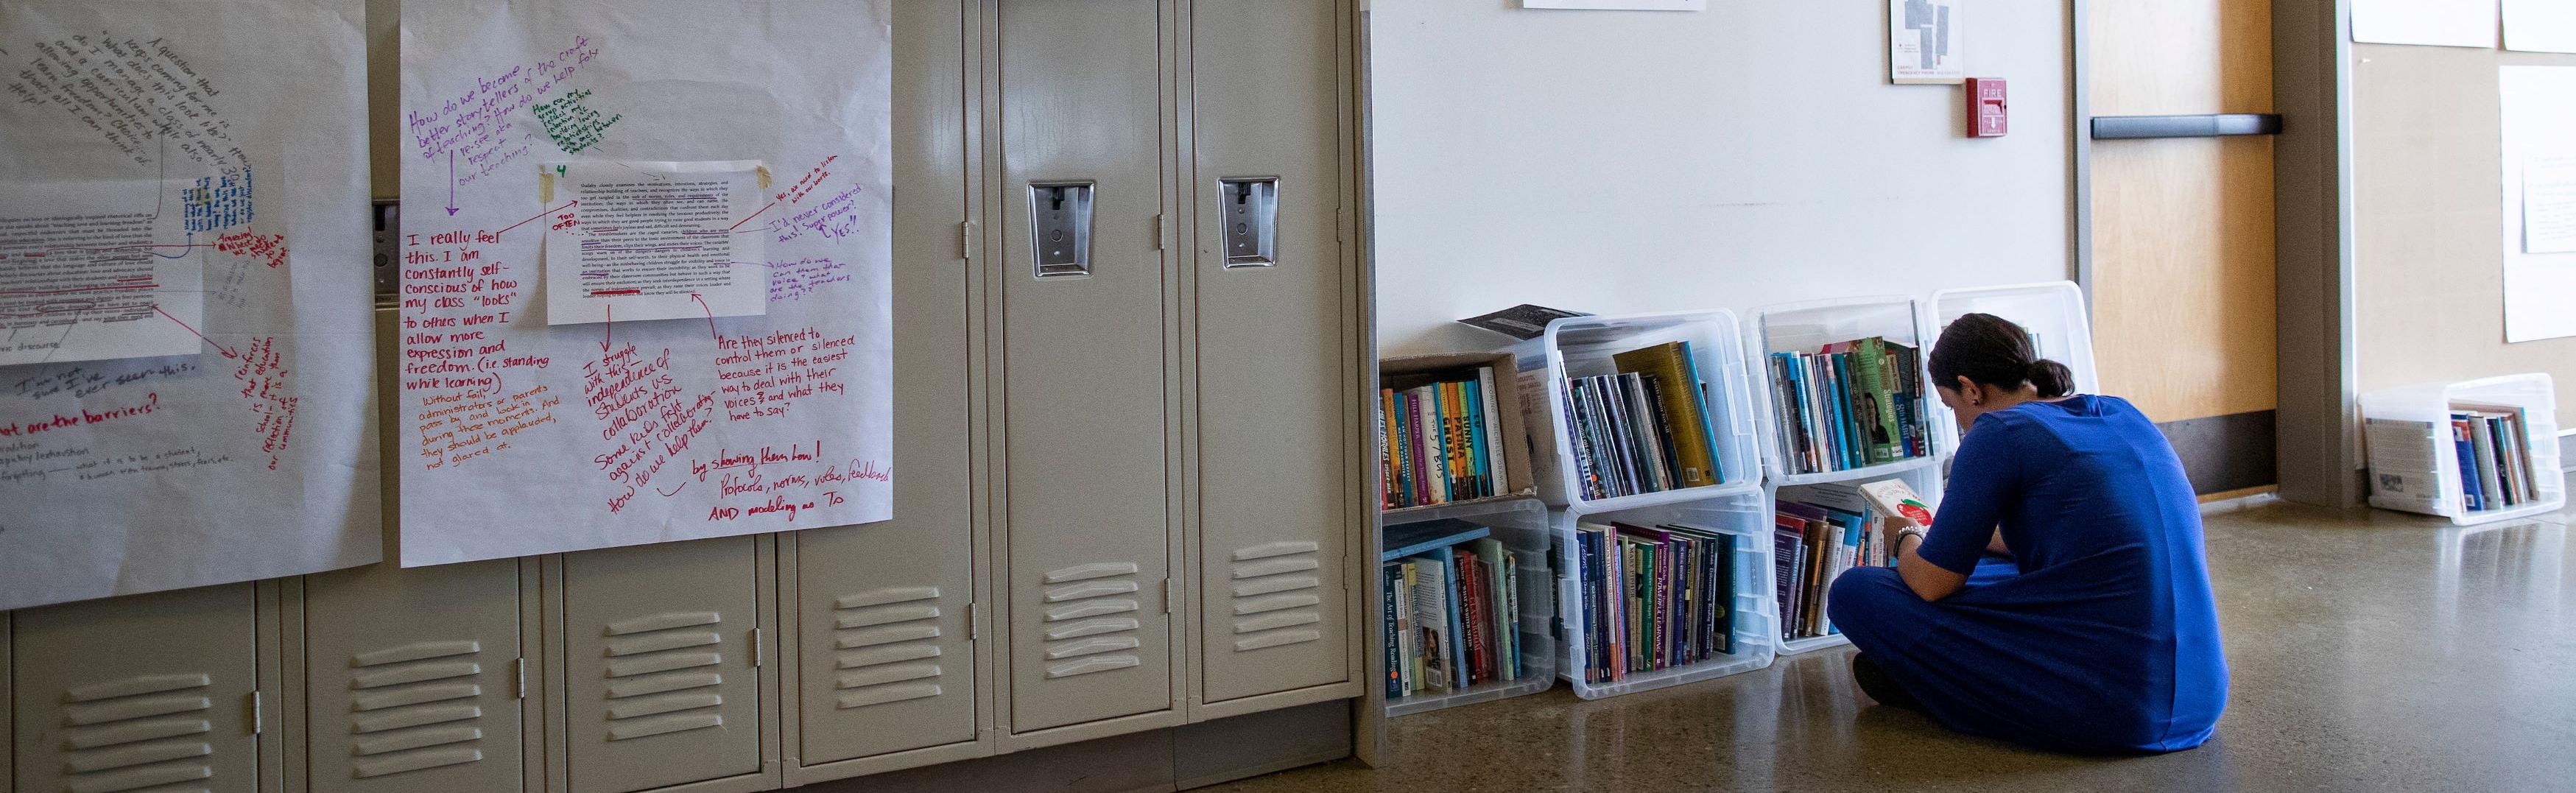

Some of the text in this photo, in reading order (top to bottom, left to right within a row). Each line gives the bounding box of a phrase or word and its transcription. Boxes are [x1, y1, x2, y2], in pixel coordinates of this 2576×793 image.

[158, 47, 196, 77] question
[197, 77, 219, 96] that
[409, 66, 520, 135] How do we become
[1984, 89, 2002, 97] FIRE
[417, 125, 449, 147] better
[557, 166, 566, 177] 4
[552, 220, 580, 230] OFTEN
[769, 219, 789, 233] I'd
[793, 206, 817, 224] never
[407, 230, 500, 250] I really feel
[779, 225, 803, 243] this!
[406, 250, 479, 264] this. I am
[406, 262, 509, 283] constantly self-
[406, 279, 518, 294] conscious of how
[406, 292, 517, 314] my class "looks"
[404, 311, 510, 328] to others when I
[407, 331, 484, 345] allow more
[407, 340, 505, 362] expression and
[716, 335, 855, 366] control them or silenced
[718, 327, 820, 350] Are they silenced to
[242, 336, 273, 398] that education
[405, 356, 549, 374] freedom. (i.e. standing
[583, 342, 636, 378] I struggle
[718, 349, 848, 379] because it is the easiest
[407, 372, 502, 394] while learning)
[585, 364, 628, 394] with this
[586, 348, 669, 406] independence of
[722, 368, 836, 395] way to deal with their
[419, 399, 492, 420] administrators
[513, 386, 548, 401] parents
[423, 390, 486, 406] Without fail,
[725, 382, 843, 409] voices and what they
[1884, 390, 1894, 422] Strategies
[28, 392, 160, 434] are the barriers?
[419, 420, 443, 434] pass
[449, 415, 462, 426] by
[469, 412, 488, 420] and
[496, 406, 518, 415] look
[422, 395, 560, 446] during these moments. And
[603, 387, 681, 440] collaboration
[729, 403, 789, 421] have to say?
[420, 412, 556, 458] they should be applauded,
[1380, 431, 1389, 461] MORALES
[1443, 417, 1454, 462] GHOST
[1454, 417, 1464, 459] PATINA
[1463, 416, 1473, 449] SUNNY
[1493, 423, 1502, 457] MICHELLE
[427, 459, 443, 470] not
[453, 448, 489, 467] glared
[693, 440, 820, 482] by showing them how!
[708, 496, 795, 522] AND modeling
